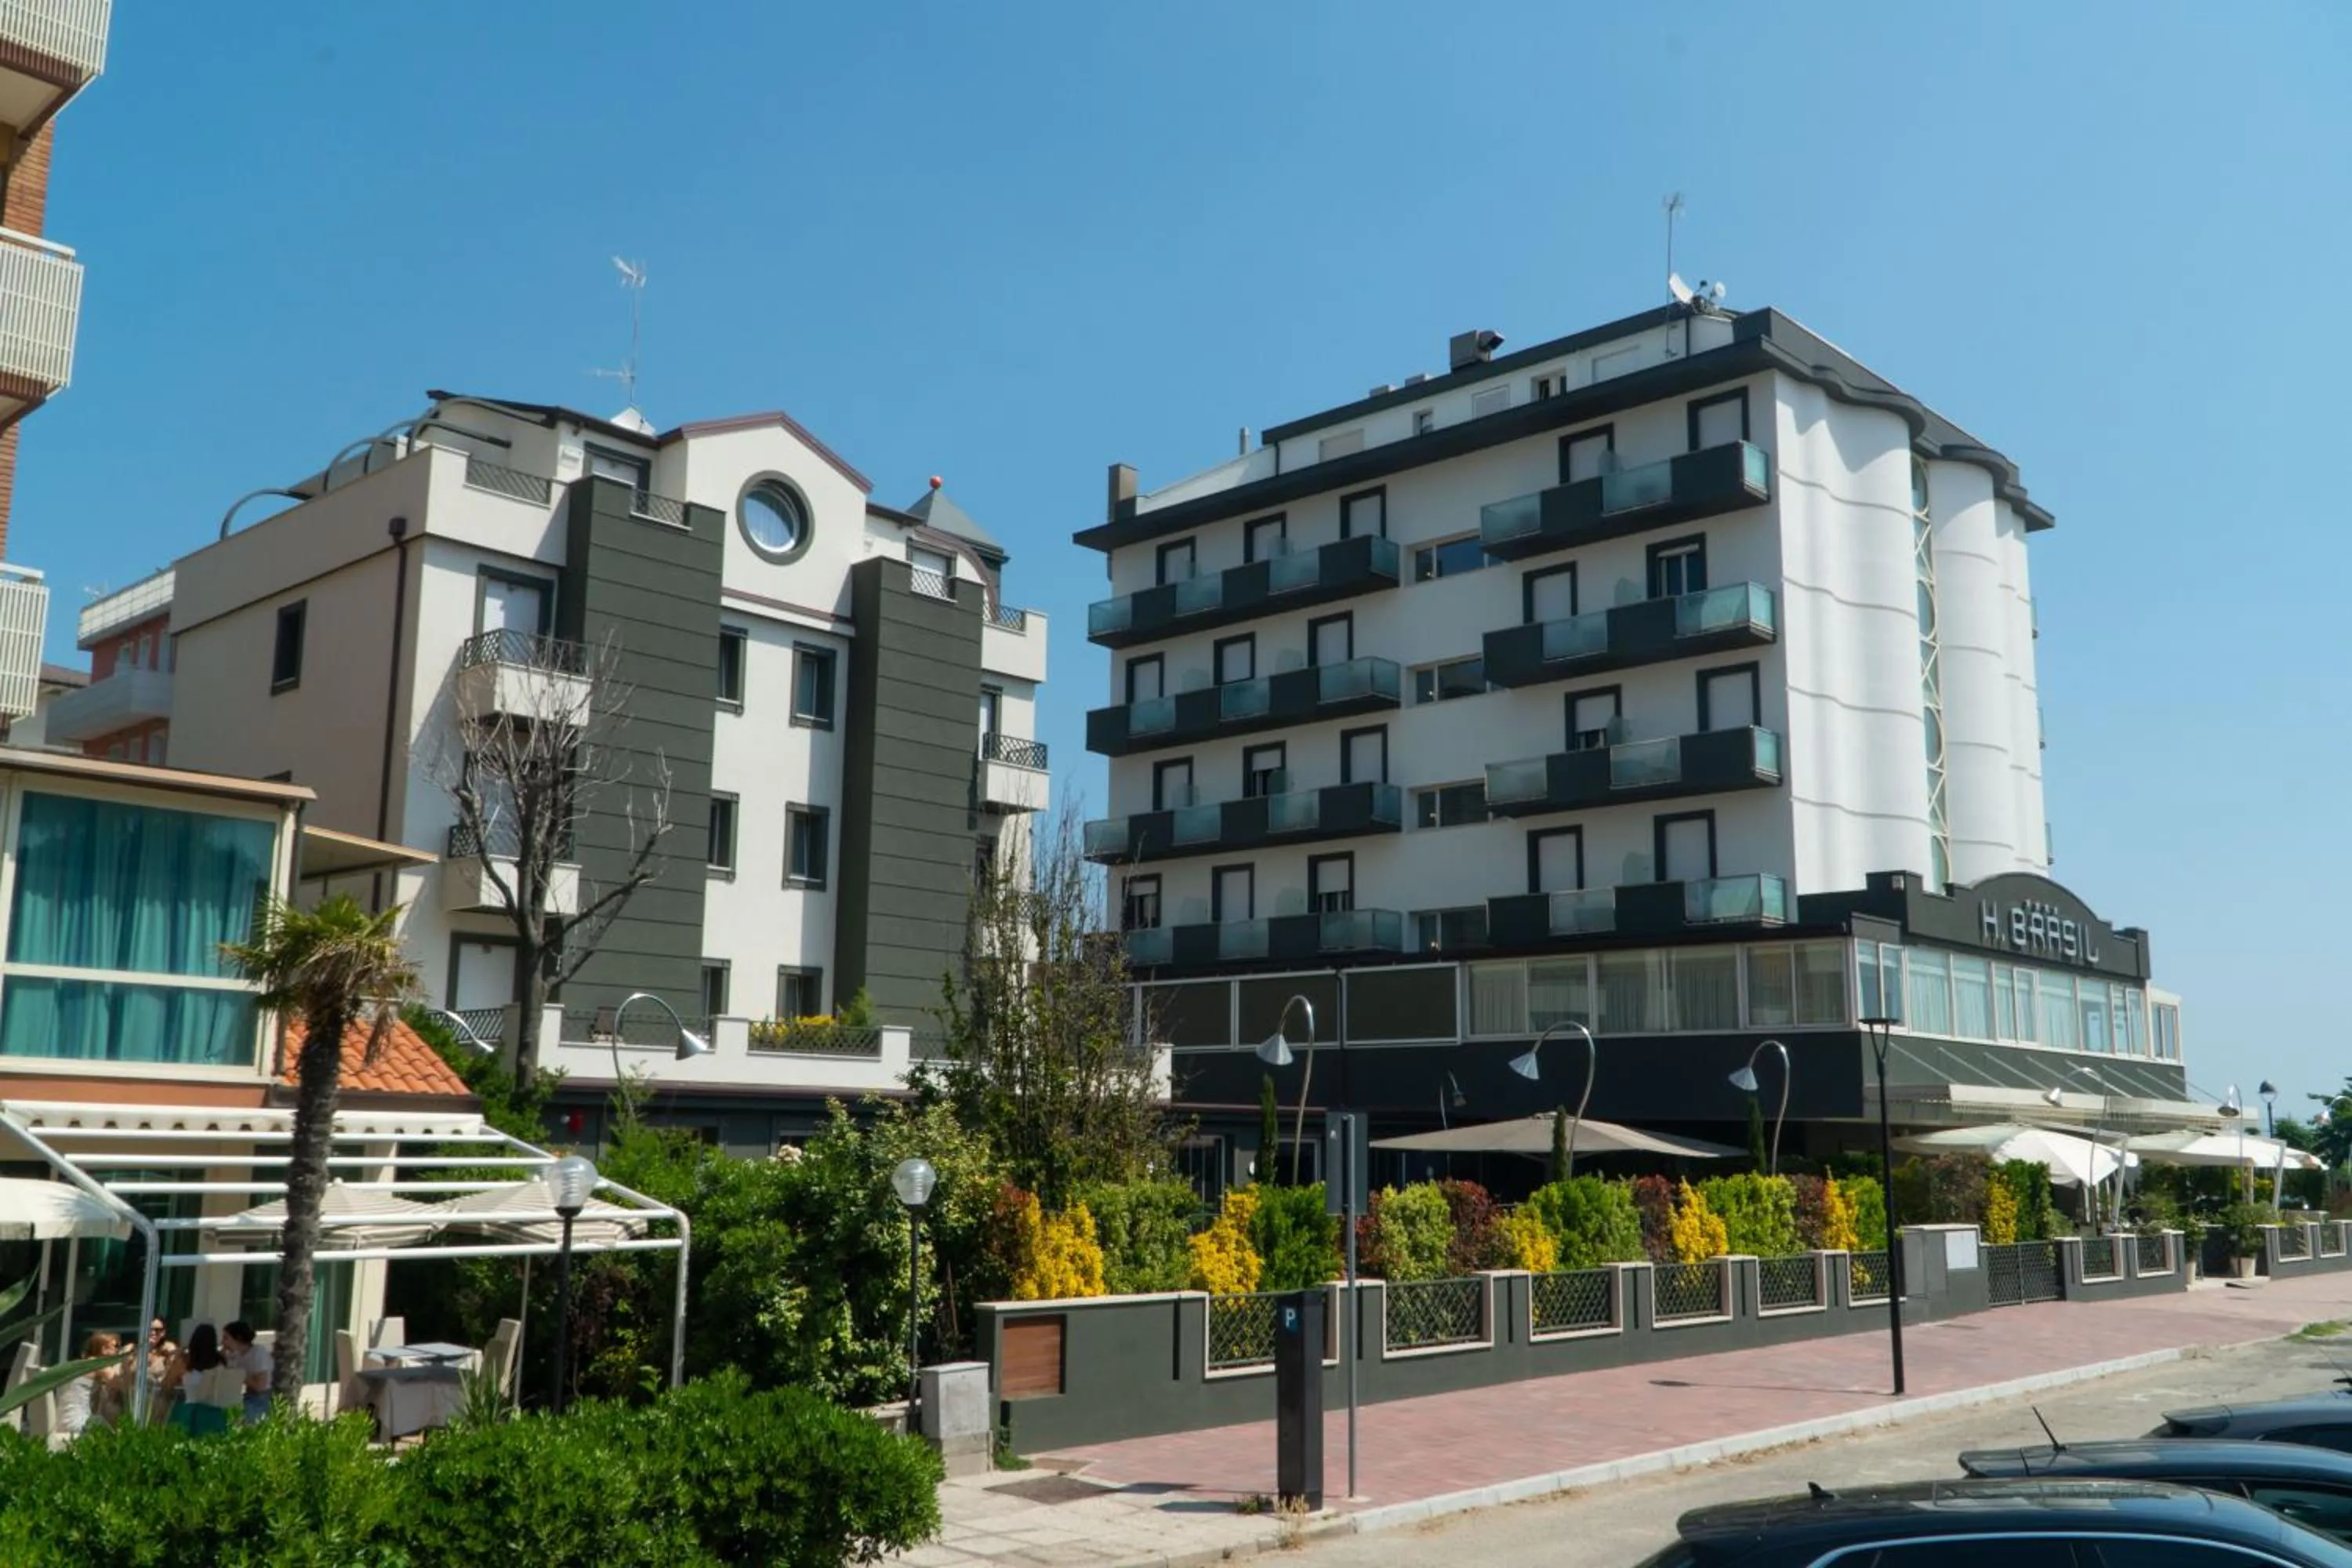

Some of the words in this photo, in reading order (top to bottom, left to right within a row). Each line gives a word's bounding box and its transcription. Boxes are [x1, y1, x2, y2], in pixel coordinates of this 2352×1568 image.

[1981, 899, 2005, 942] H.
[2011, 906, 2100, 964] BRASIL
[1285, 1307, 1296, 1327] P
